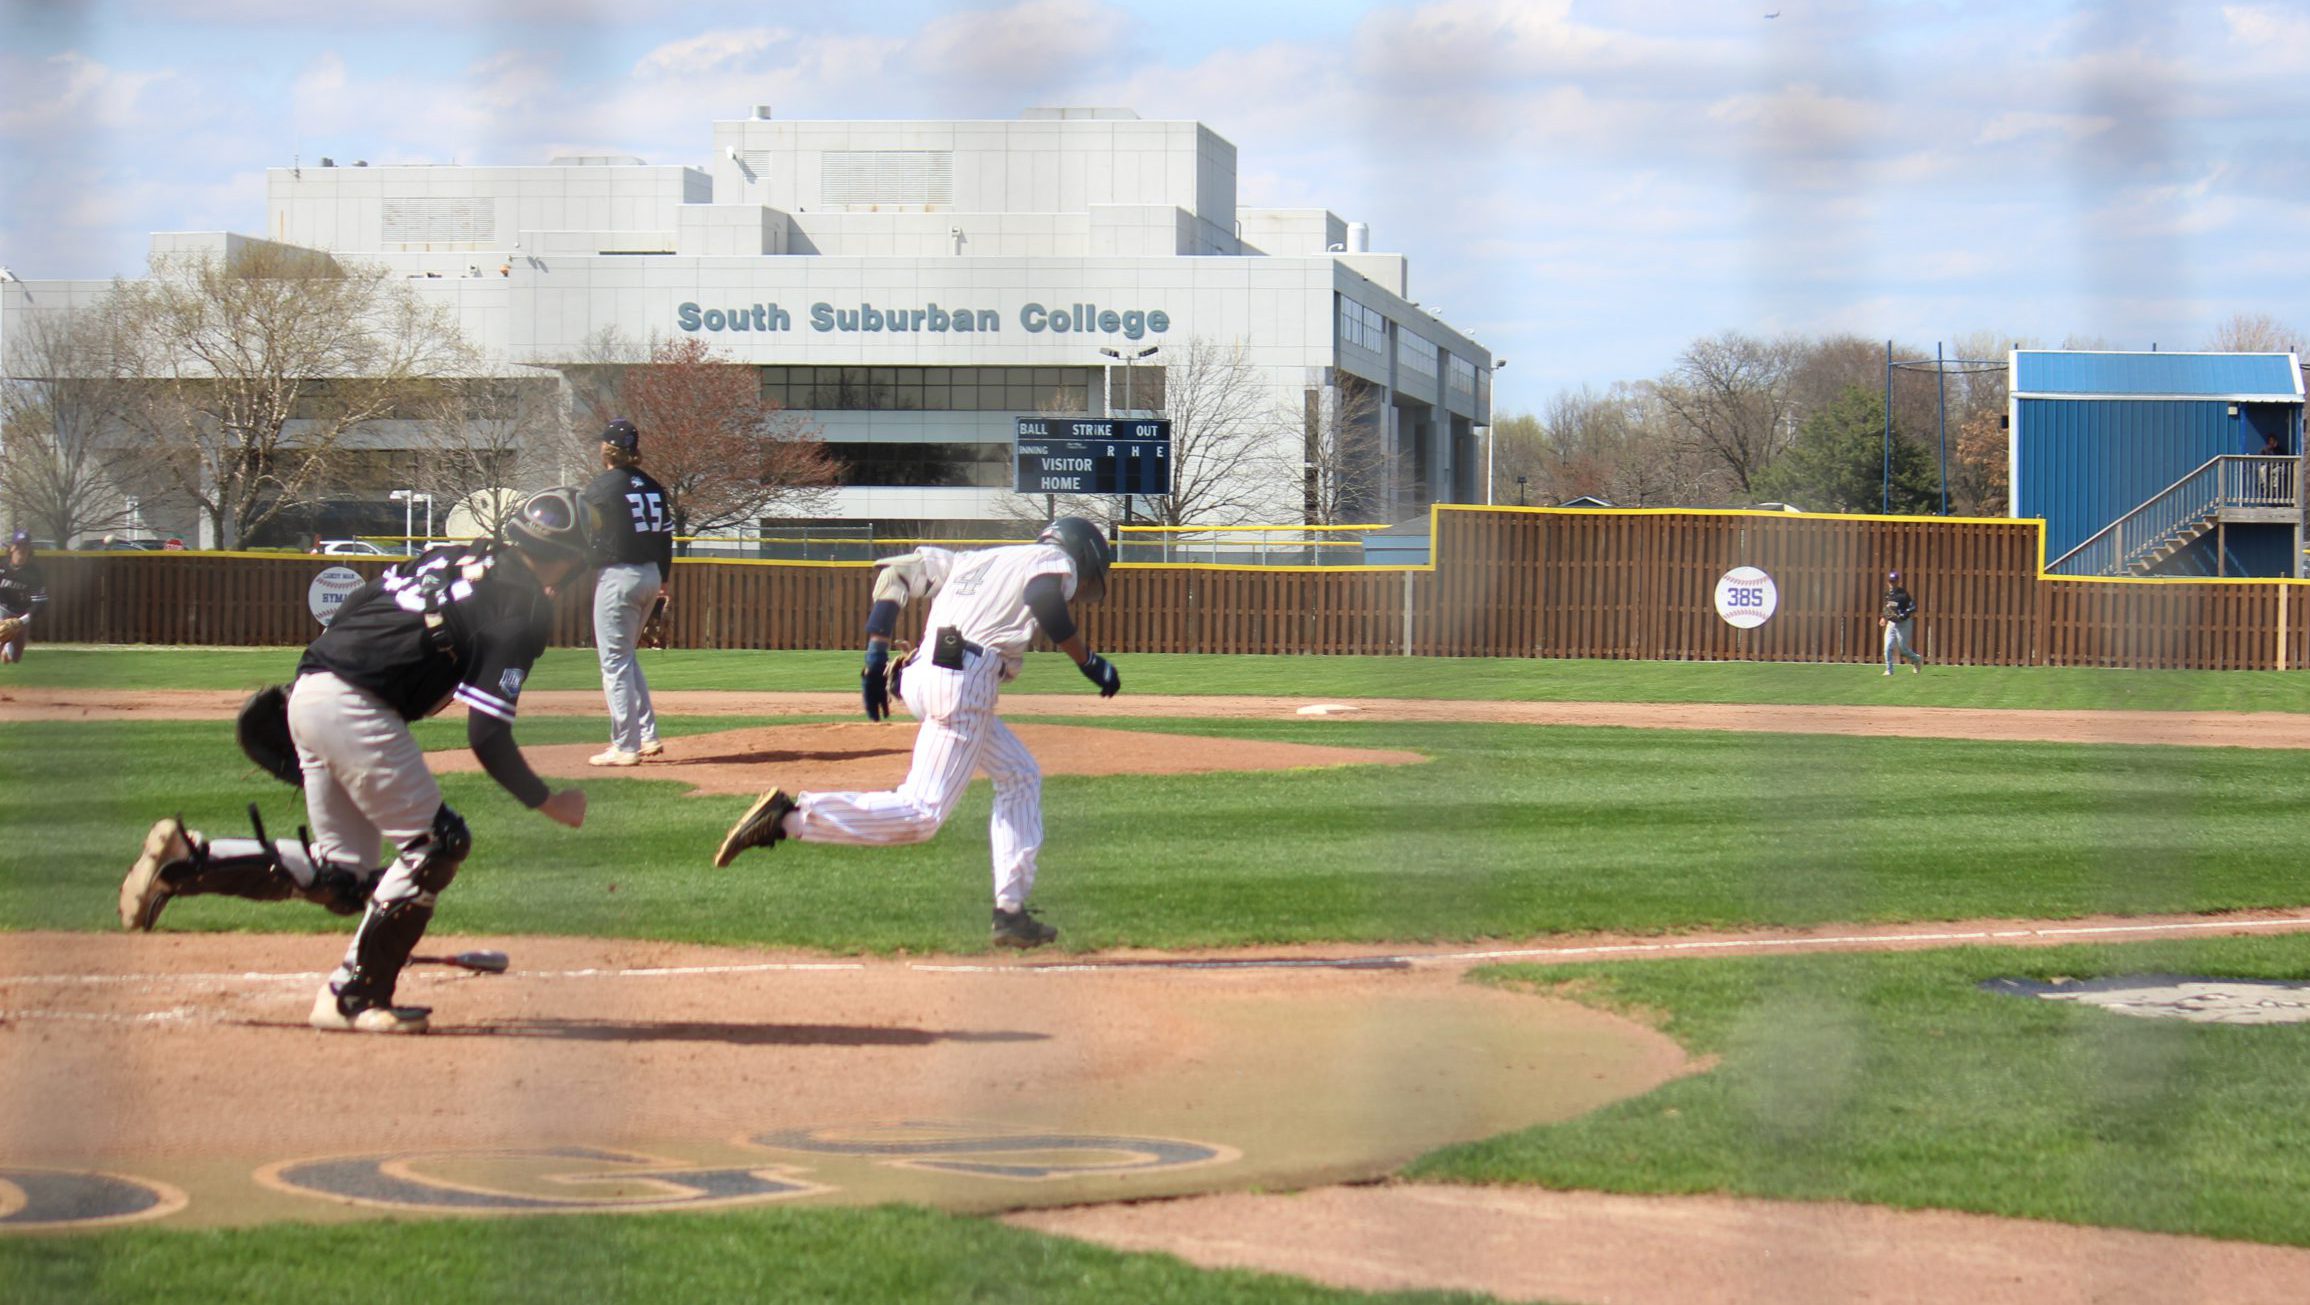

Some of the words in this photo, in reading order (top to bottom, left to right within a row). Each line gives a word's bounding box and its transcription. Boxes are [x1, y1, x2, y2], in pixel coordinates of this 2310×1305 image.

[677, 302, 791, 333] South
[809, 302, 1001, 333] Suburban
[1018, 302, 1171, 340] College
[1019, 423, 1048, 435] BALL
[1072, 424, 1112, 436] STRIKE
[1136, 425, 1158, 437] OUT
[1019, 445, 1048, 455] INNING
[1107, 445, 1115, 457] R
[1131, 445, 1140, 457] H
[1156, 446, 1164, 458] E
[1041, 458, 1092, 472] VISITOR
[1041, 476, 1081, 490] HOME
[1727, 587, 1763, 607] 385
